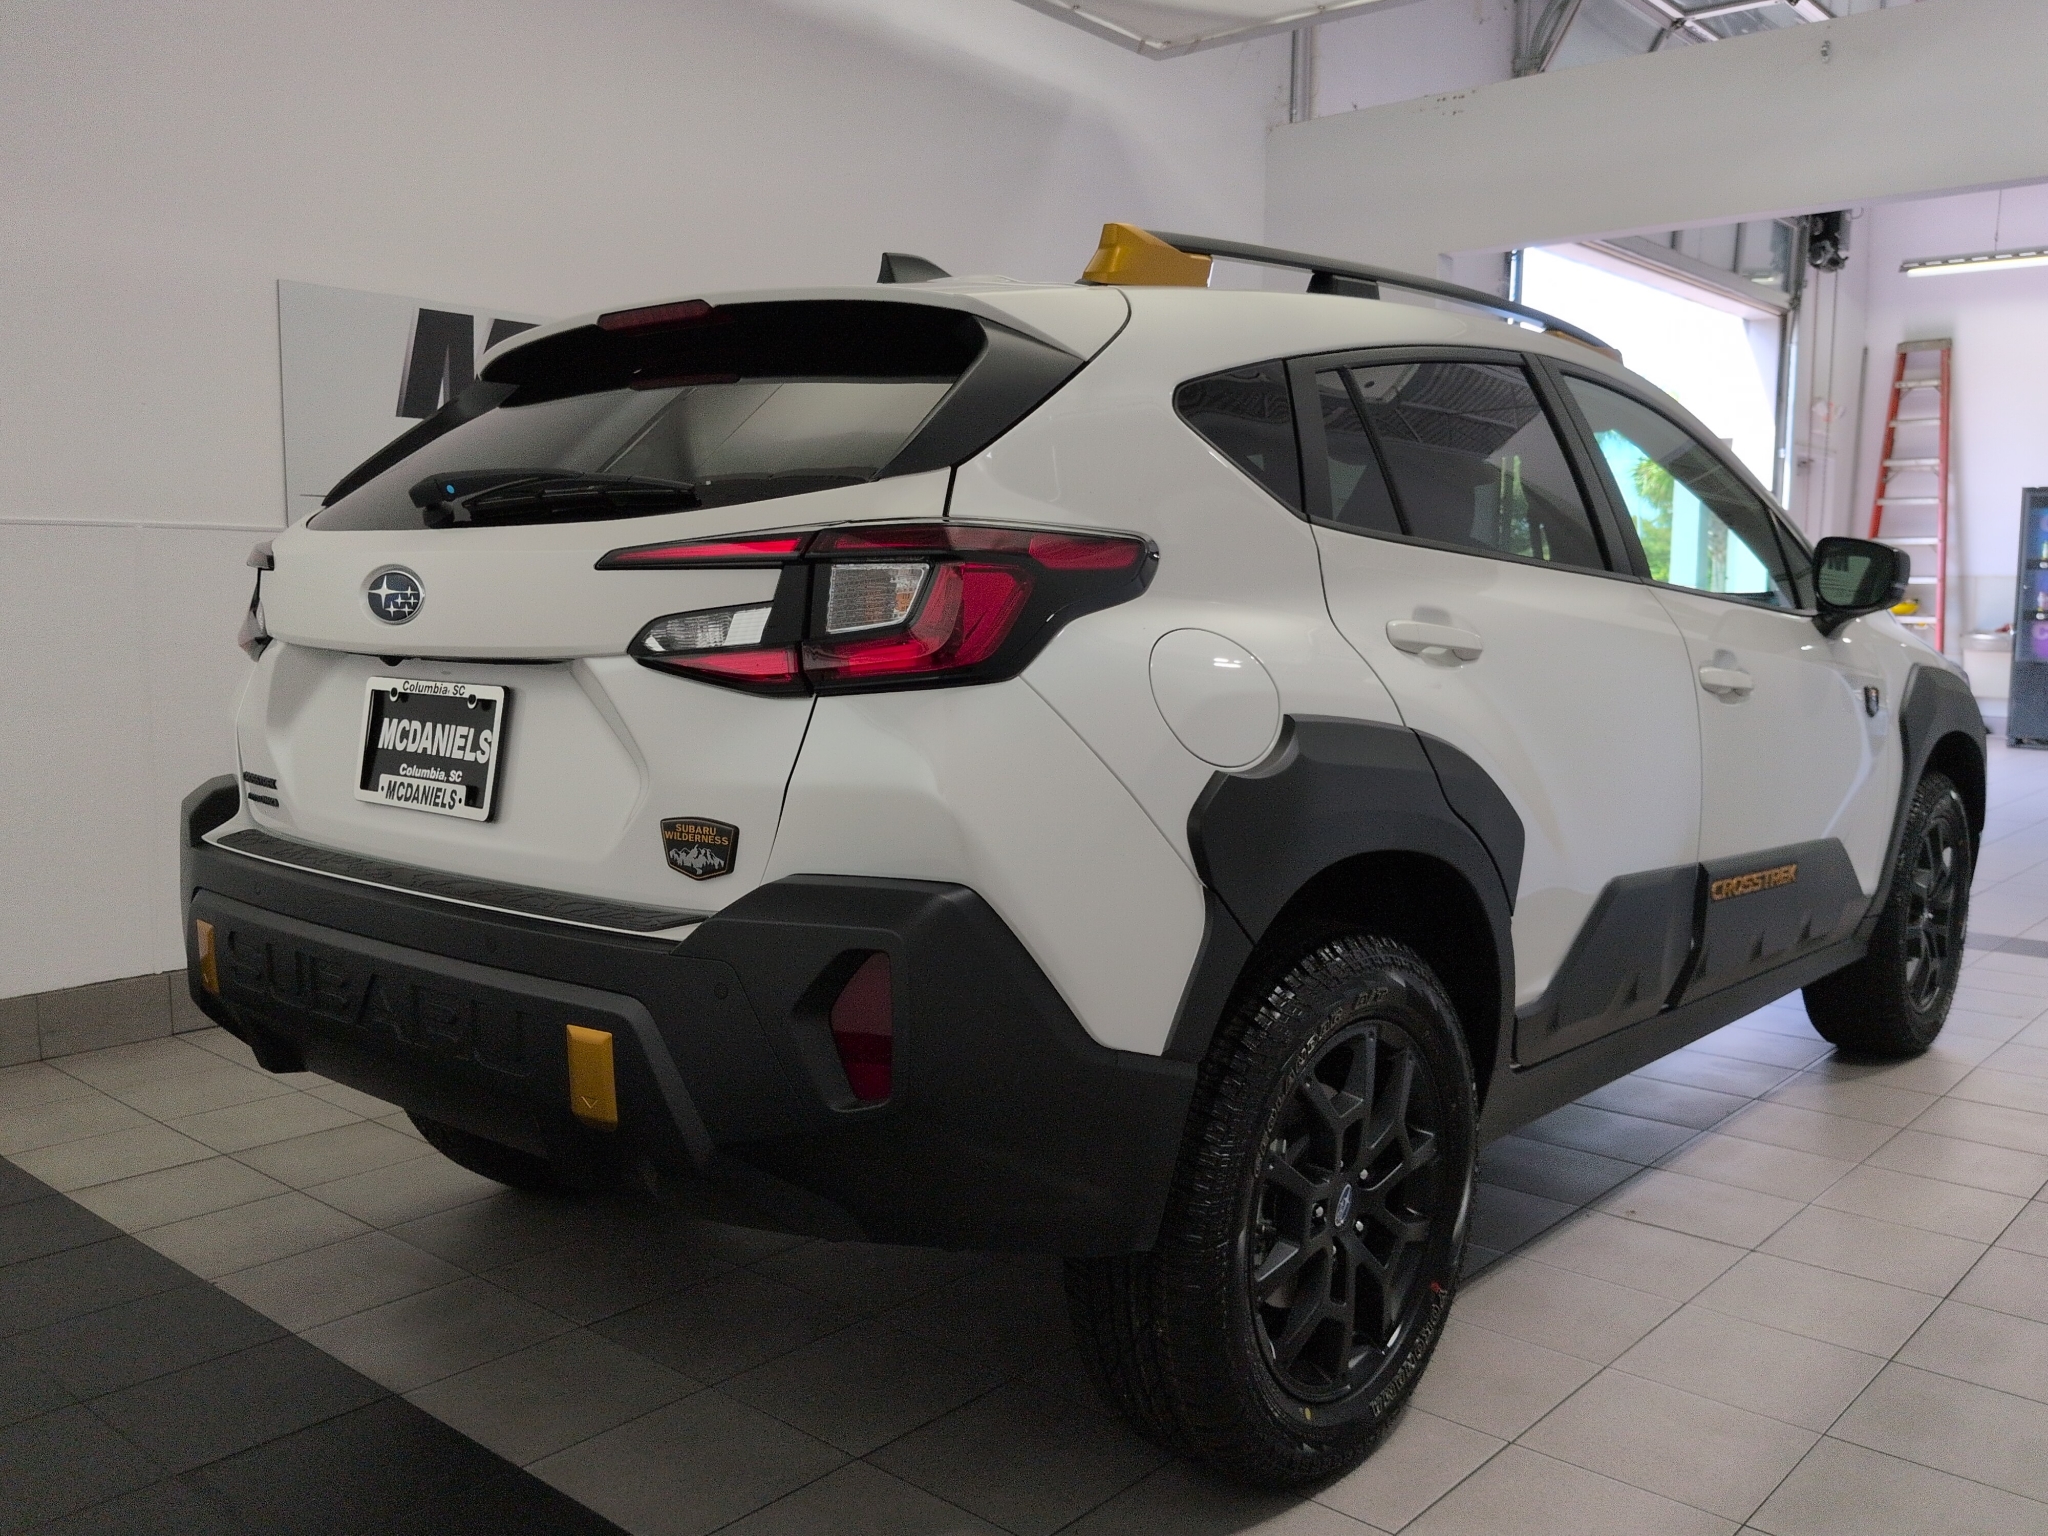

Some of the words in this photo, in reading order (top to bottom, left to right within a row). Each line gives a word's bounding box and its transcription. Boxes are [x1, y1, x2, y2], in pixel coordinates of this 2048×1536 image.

[452, 685, 466, 696] SC
[377, 717, 493, 764] MCDANIELS
[399, 763, 447, 781] Columbia,
[448, 770, 463, 782] SC
[385, 779, 458, 810] MCDANIELS
[664, 830, 729, 846] WILDERNESS
[675, 823, 717, 836] SUBARU
[1711, 863, 1797, 900] CROSSTREK
